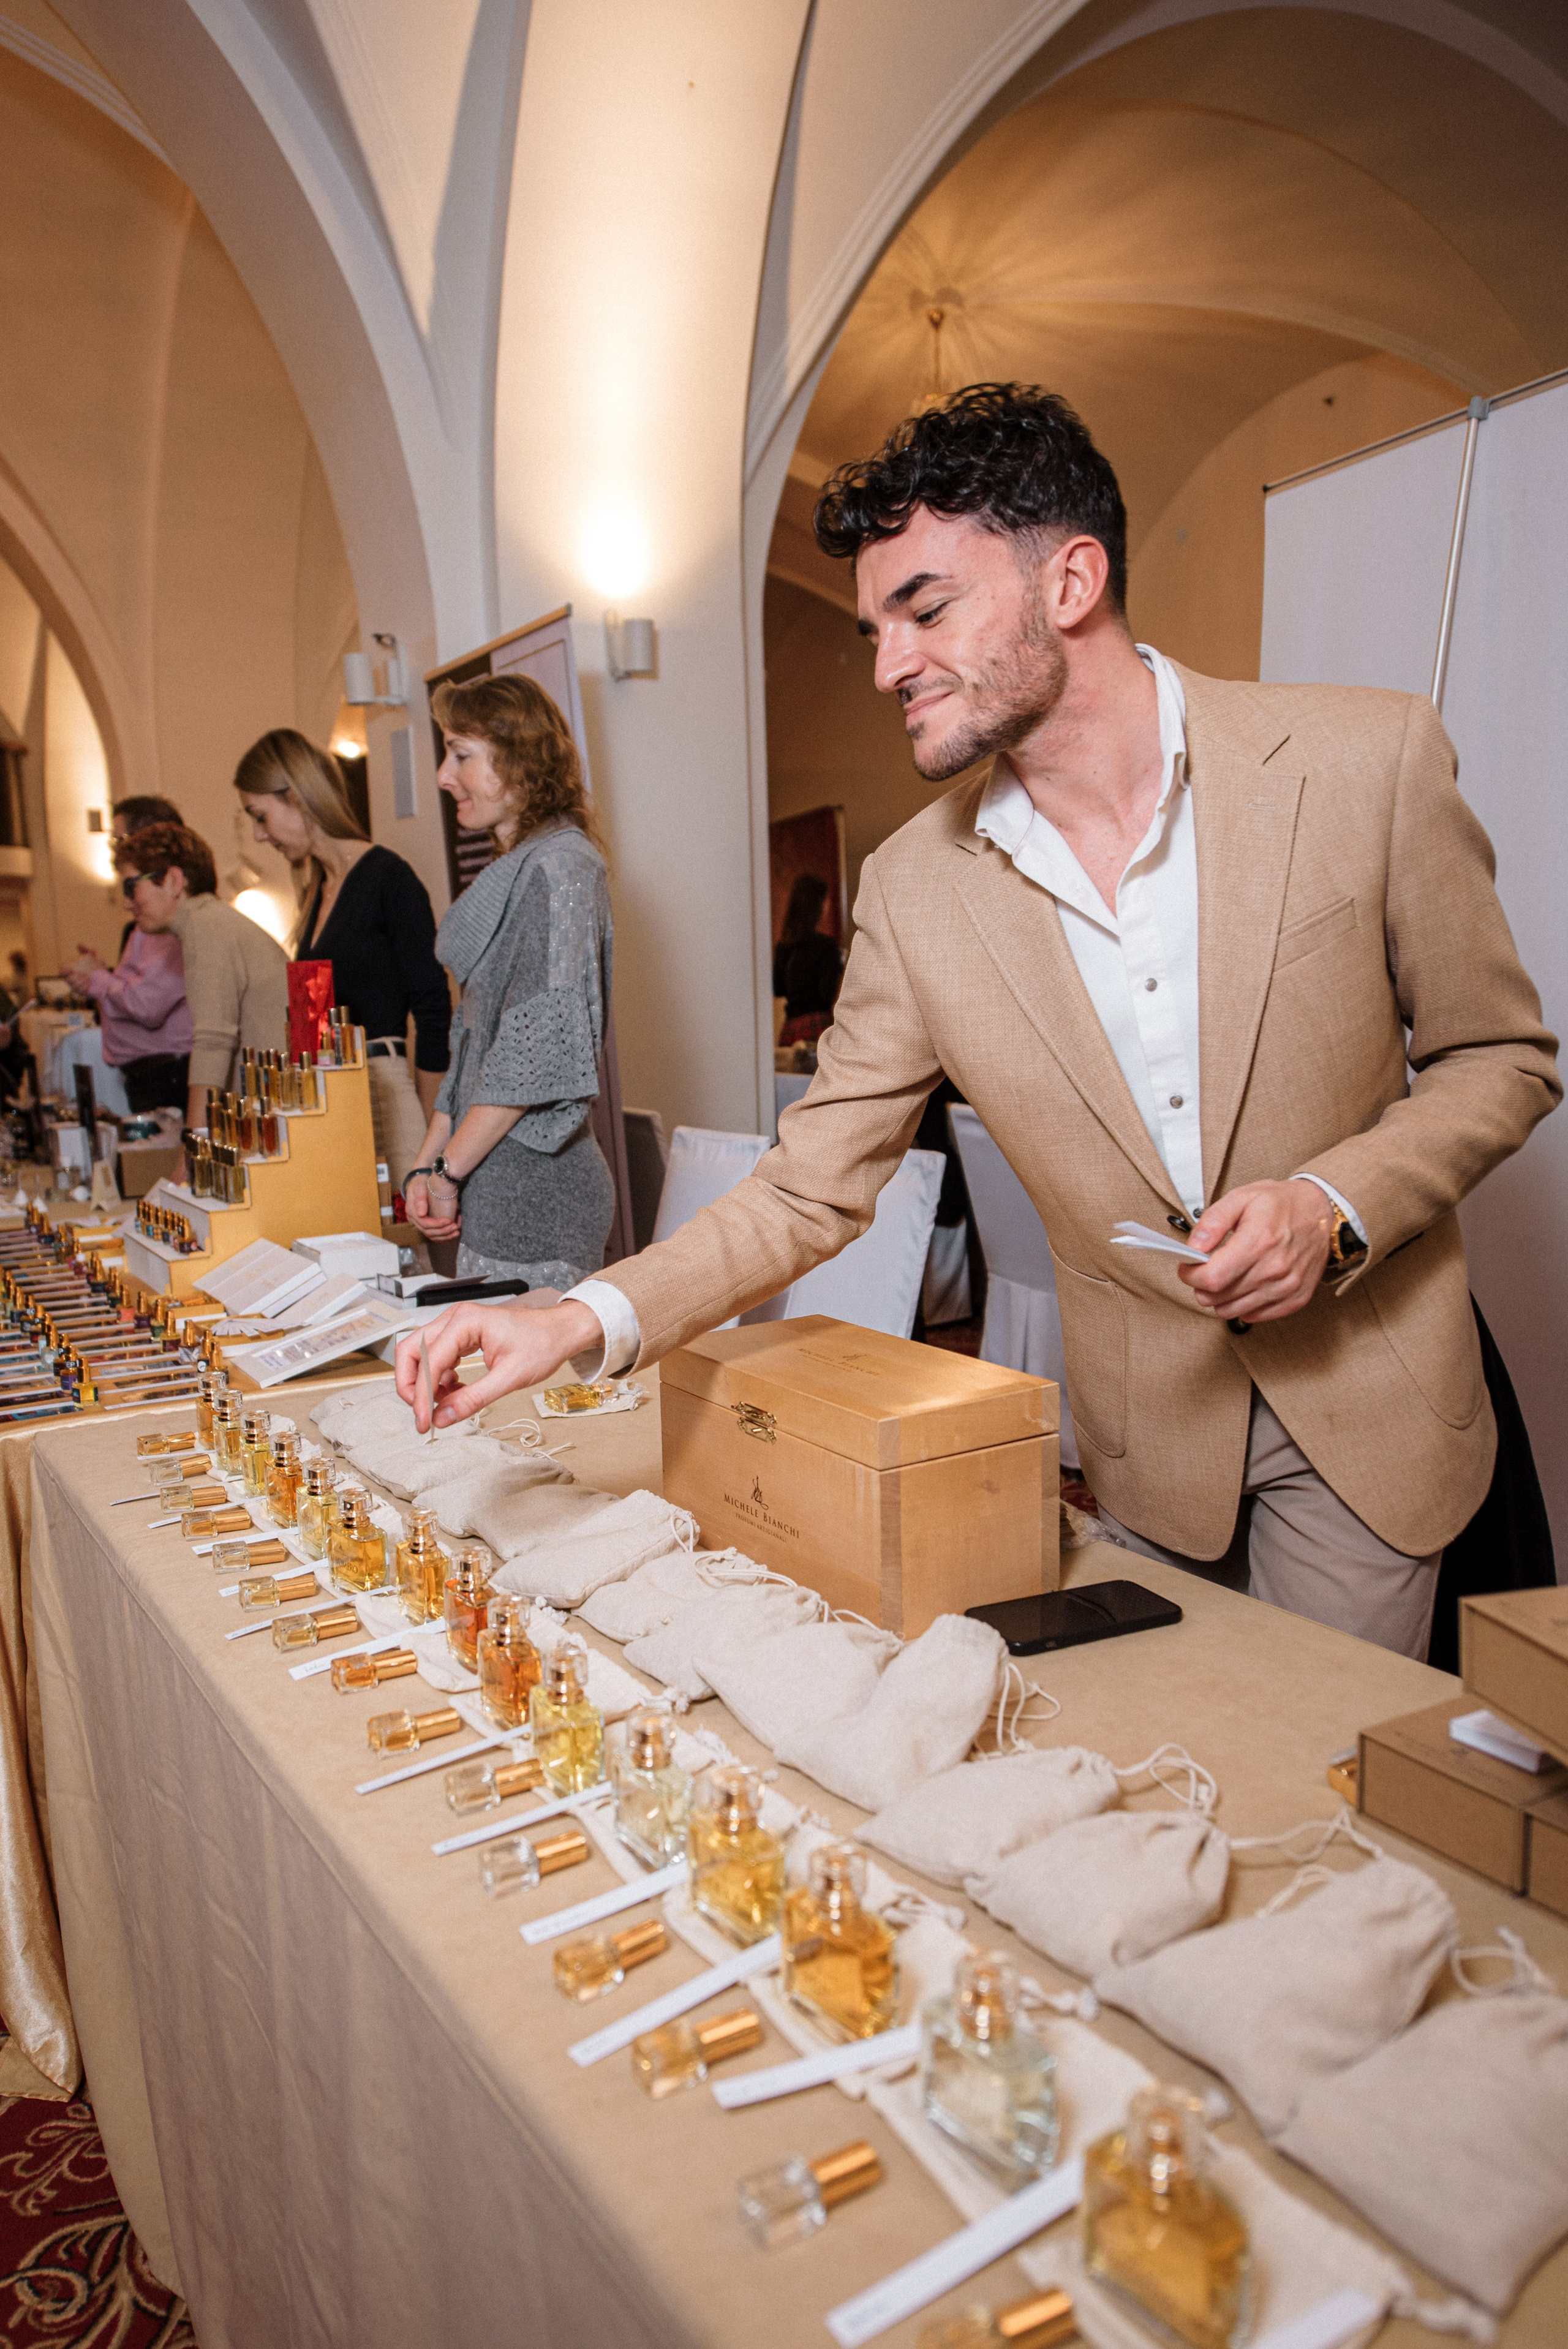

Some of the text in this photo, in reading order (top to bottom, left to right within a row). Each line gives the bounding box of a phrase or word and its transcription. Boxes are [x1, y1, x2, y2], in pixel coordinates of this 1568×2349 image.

[724, 1493, 799, 1539] MICHELE BIANCHI
[736, 1513, 756, 1528] PROFUMI
